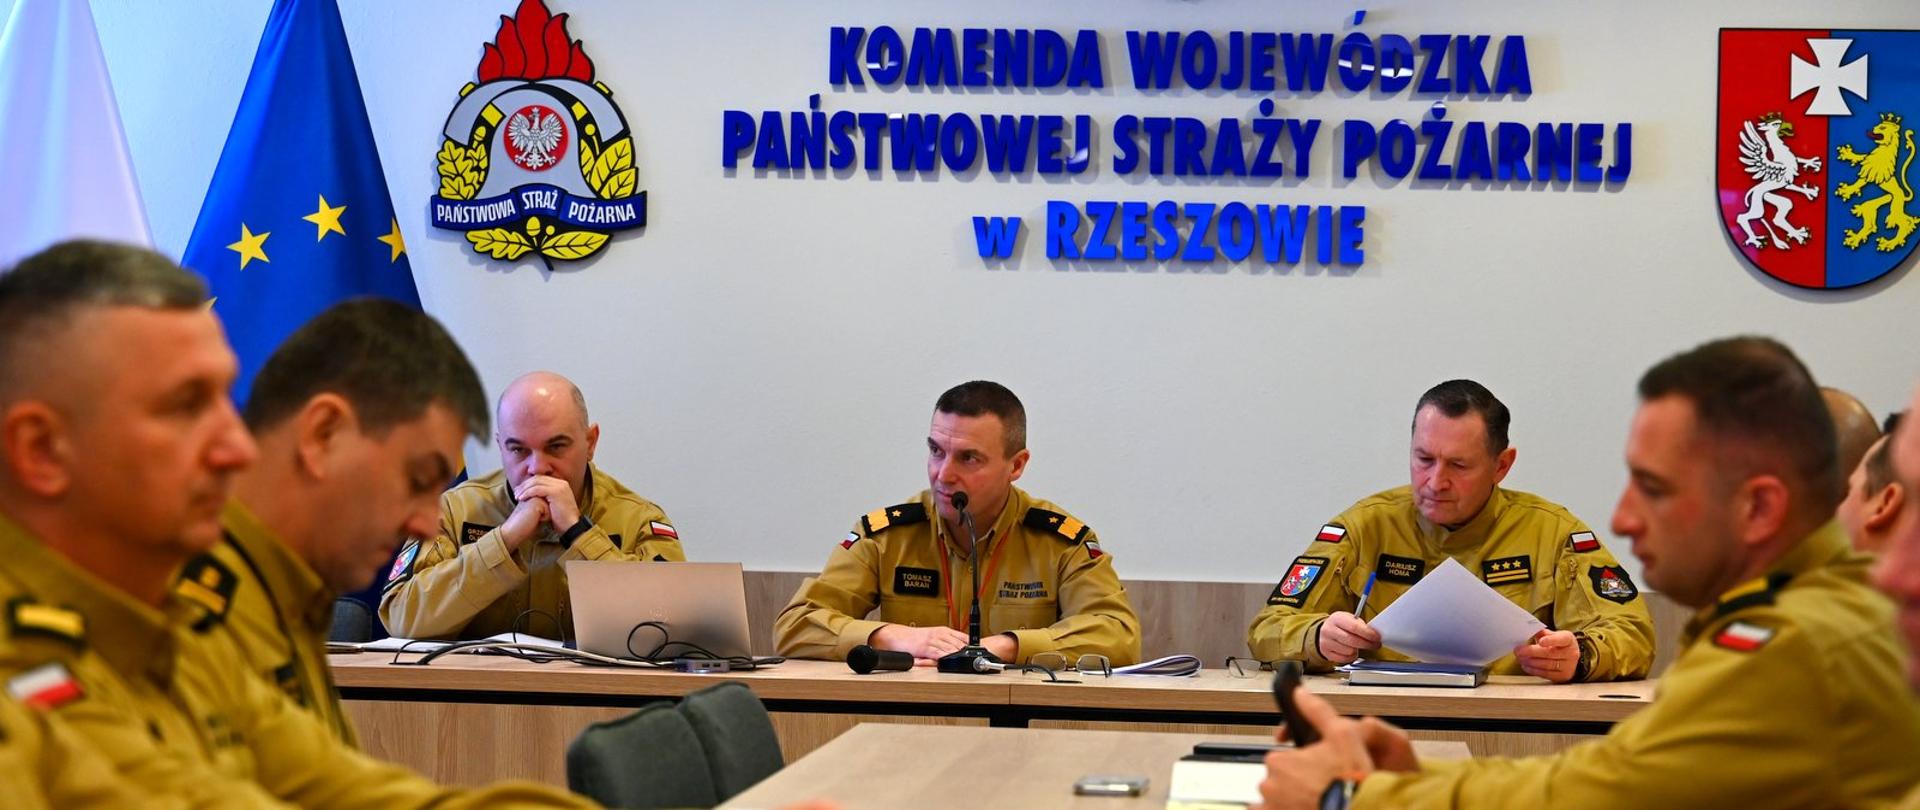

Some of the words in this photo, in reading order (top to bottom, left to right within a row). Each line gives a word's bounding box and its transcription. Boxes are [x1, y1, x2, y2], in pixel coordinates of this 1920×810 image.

[829, 26, 1103, 87] KOMENDA
[1126, 10, 1532, 95] WOJEWÓDZKA
[723, 94, 1091, 173] PAŃSTWOWEJ
[1113, 99, 1321, 178] STRAŻY
[1343, 101, 1632, 182] POŻARNEJ
[437, 198, 516, 223] PAŃSTWOWA
[522, 189, 559, 211] STRAŻ
[568, 202, 636, 223] POŻARNA
[1046, 200, 1365, 265] RZESZOWIE
[1385, 561, 1417, 572] DARIUSZ
[1388, 568, 1410, 577] HOMA
[902, 573, 932, 583] TOMASZ
[904, 580, 930, 589] BARAN
